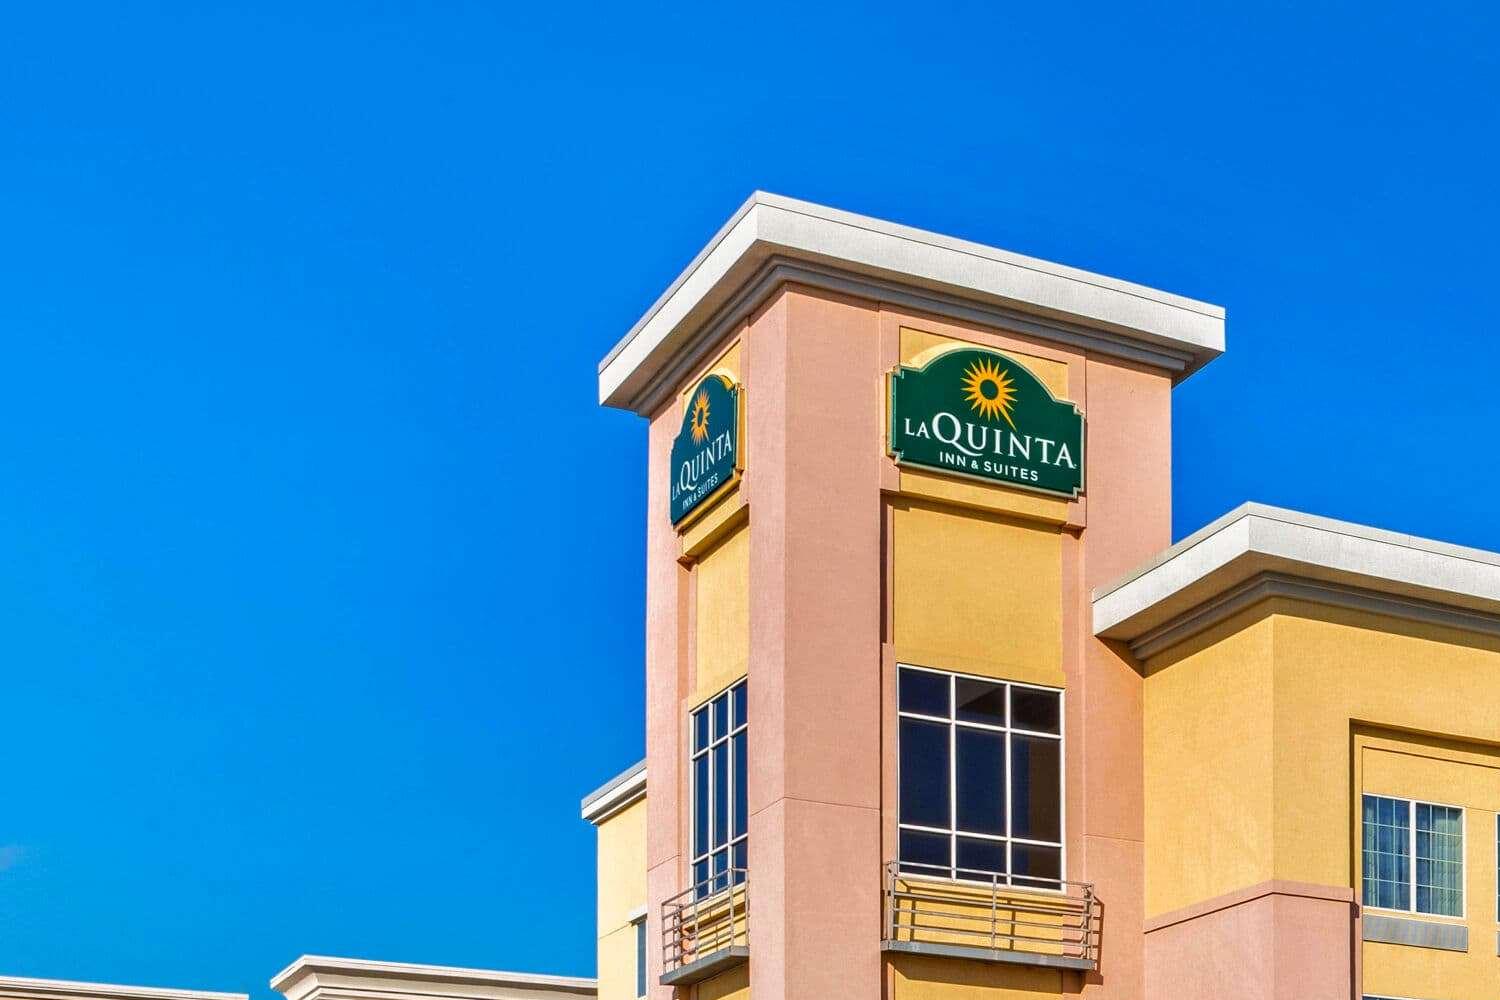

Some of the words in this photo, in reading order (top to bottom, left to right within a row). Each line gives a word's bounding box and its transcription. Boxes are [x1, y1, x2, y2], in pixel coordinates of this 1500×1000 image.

[904, 418, 931, 440] LA
[932, 412, 1076, 469] QUINTA
[672, 482, 681, 501] LA
[680, 430, 732, 491] QUINTA
[939, 451, 967, 467] INN
[971, 459, 979, 470] &
[983, 460, 1039, 482] SUITES
[682, 494, 693, 510] INN
[697, 472, 718, 498] SUITES
